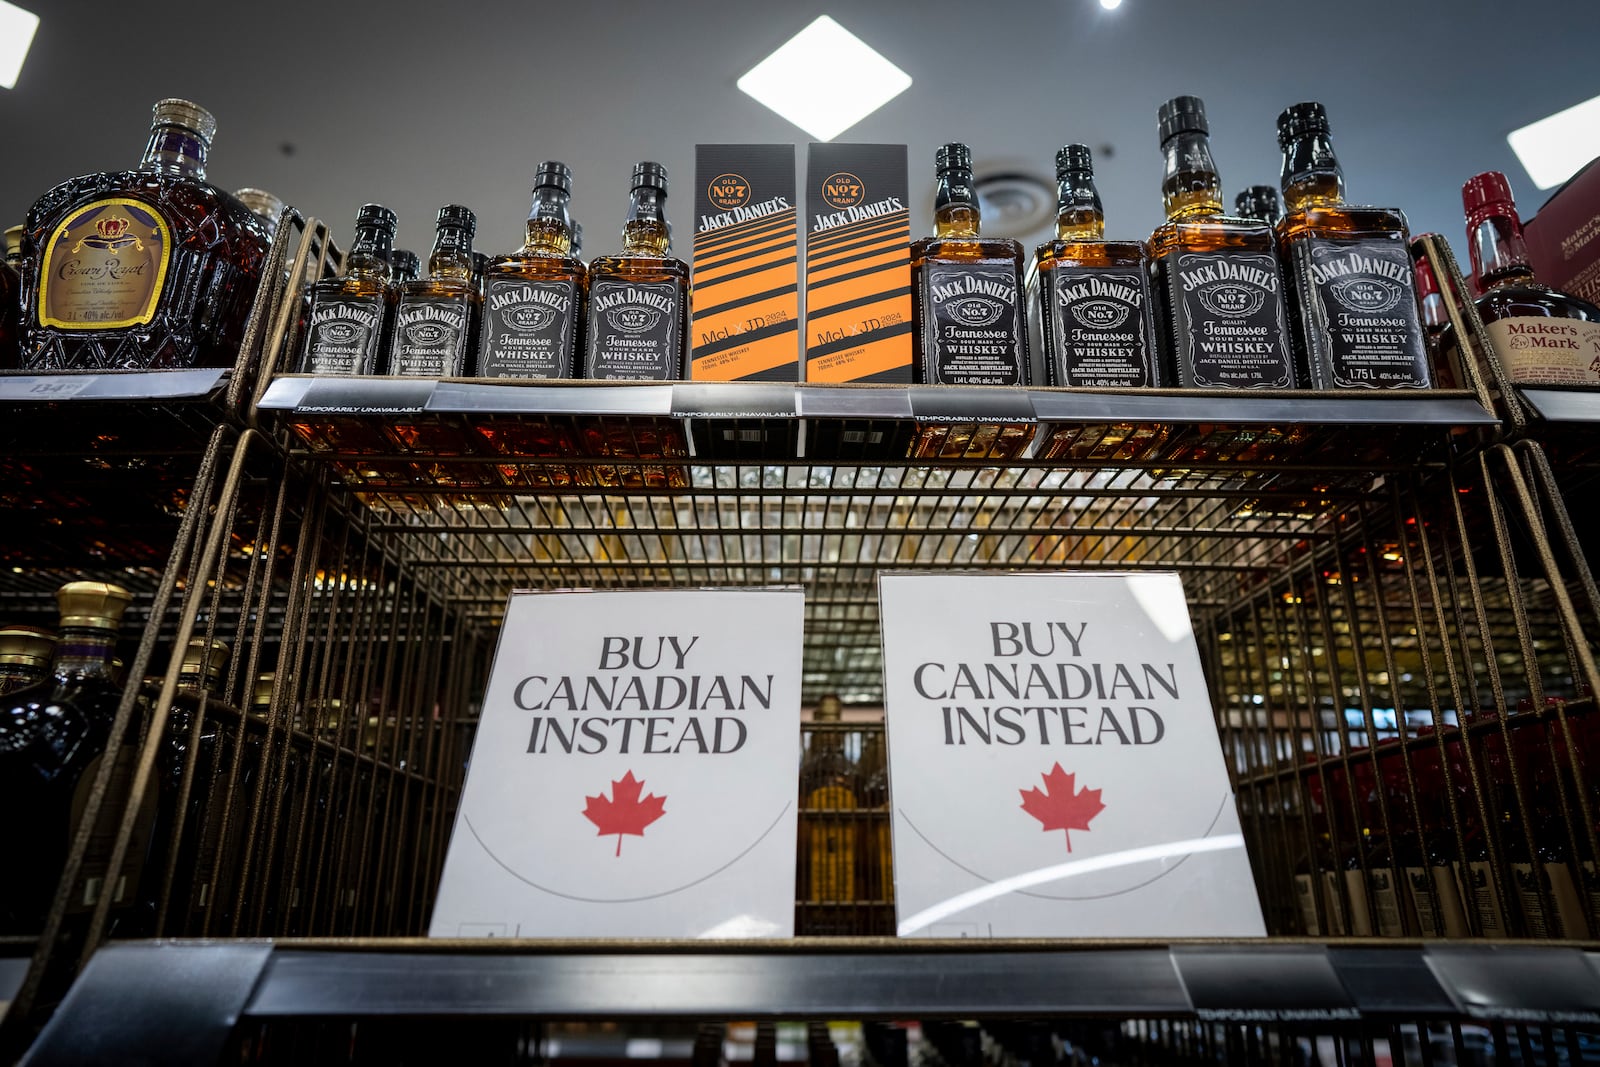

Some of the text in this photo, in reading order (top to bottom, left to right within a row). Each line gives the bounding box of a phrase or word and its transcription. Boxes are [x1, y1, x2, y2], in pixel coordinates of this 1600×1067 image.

[699, 196, 789, 233] JACK DANIEL'S
[813, 197, 903, 233] JACK DANIEL'S
[59, 258, 151, 280] Crown Royal
[1310, 252, 1413, 287] JACK DANIEL'S
[1179, 260, 1280, 294] JACK DANIEL'S
[931, 275, 1018, 306] JACK DANIEL'S
[1056, 278, 1144, 309] JACK DANIEL'S
[490, 286, 571, 314] JACK DANIEL'S
[595, 287, 675, 315] JACK DANIEL'S
[311, 305, 379, 329] JACK DANIEL'S
[398, 305, 465, 329] JACK DANIEL'S
[765, 310, 787, 321] 2024
[880, 312, 902, 324] 2024
[1337, 313, 1407, 327] Tennessee
[944, 325, 1008, 339] Tennessee
[1071, 328, 1134, 341] Tennessee
[1203, 321, 1269, 335] Tennessee
[1508, 323, 1578, 336] Maker's
[500, 334, 552, 346] Tennessee
[606, 335, 658, 347] Tennessee
[1341, 334, 1408, 344] WHISKEY
[1530, 336, 1580, 350] Mark
[312, 343, 363, 354] Tennessee
[401, 345, 451, 355] Tennessee
[946, 345, 1008, 354] WHISKEY
[1073, 348, 1135, 357] WHISKEY
[1200, 342, 1275, 353] WHISKEY
[311, 357, 358, 366] WHISKEY
[495, 351, 555, 360] WHISKEY
[601, 352, 661, 361] WHISKEY
[701, 347, 750, 366] TENNESSEE WHISKEY
[817, 348, 865, 366] TENNESSEE WHISKEY
[400, 359, 448, 367] WHISKEY
[1350, 368, 1369, 380] 1.75
[1370, 368, 1377, 379] L
[1379, 372, 1392, 380] 40%
[990, 621, 1088, 657] BUY
[598, 635, 700, 671] BUY
[913, 662, 1180, 701] CANADIAN
[512, 674, 775, 712] CANADIAN
[941, 706, 1166, 746] INSTEAD
[526, 716, 748, 755] INSTEAD
